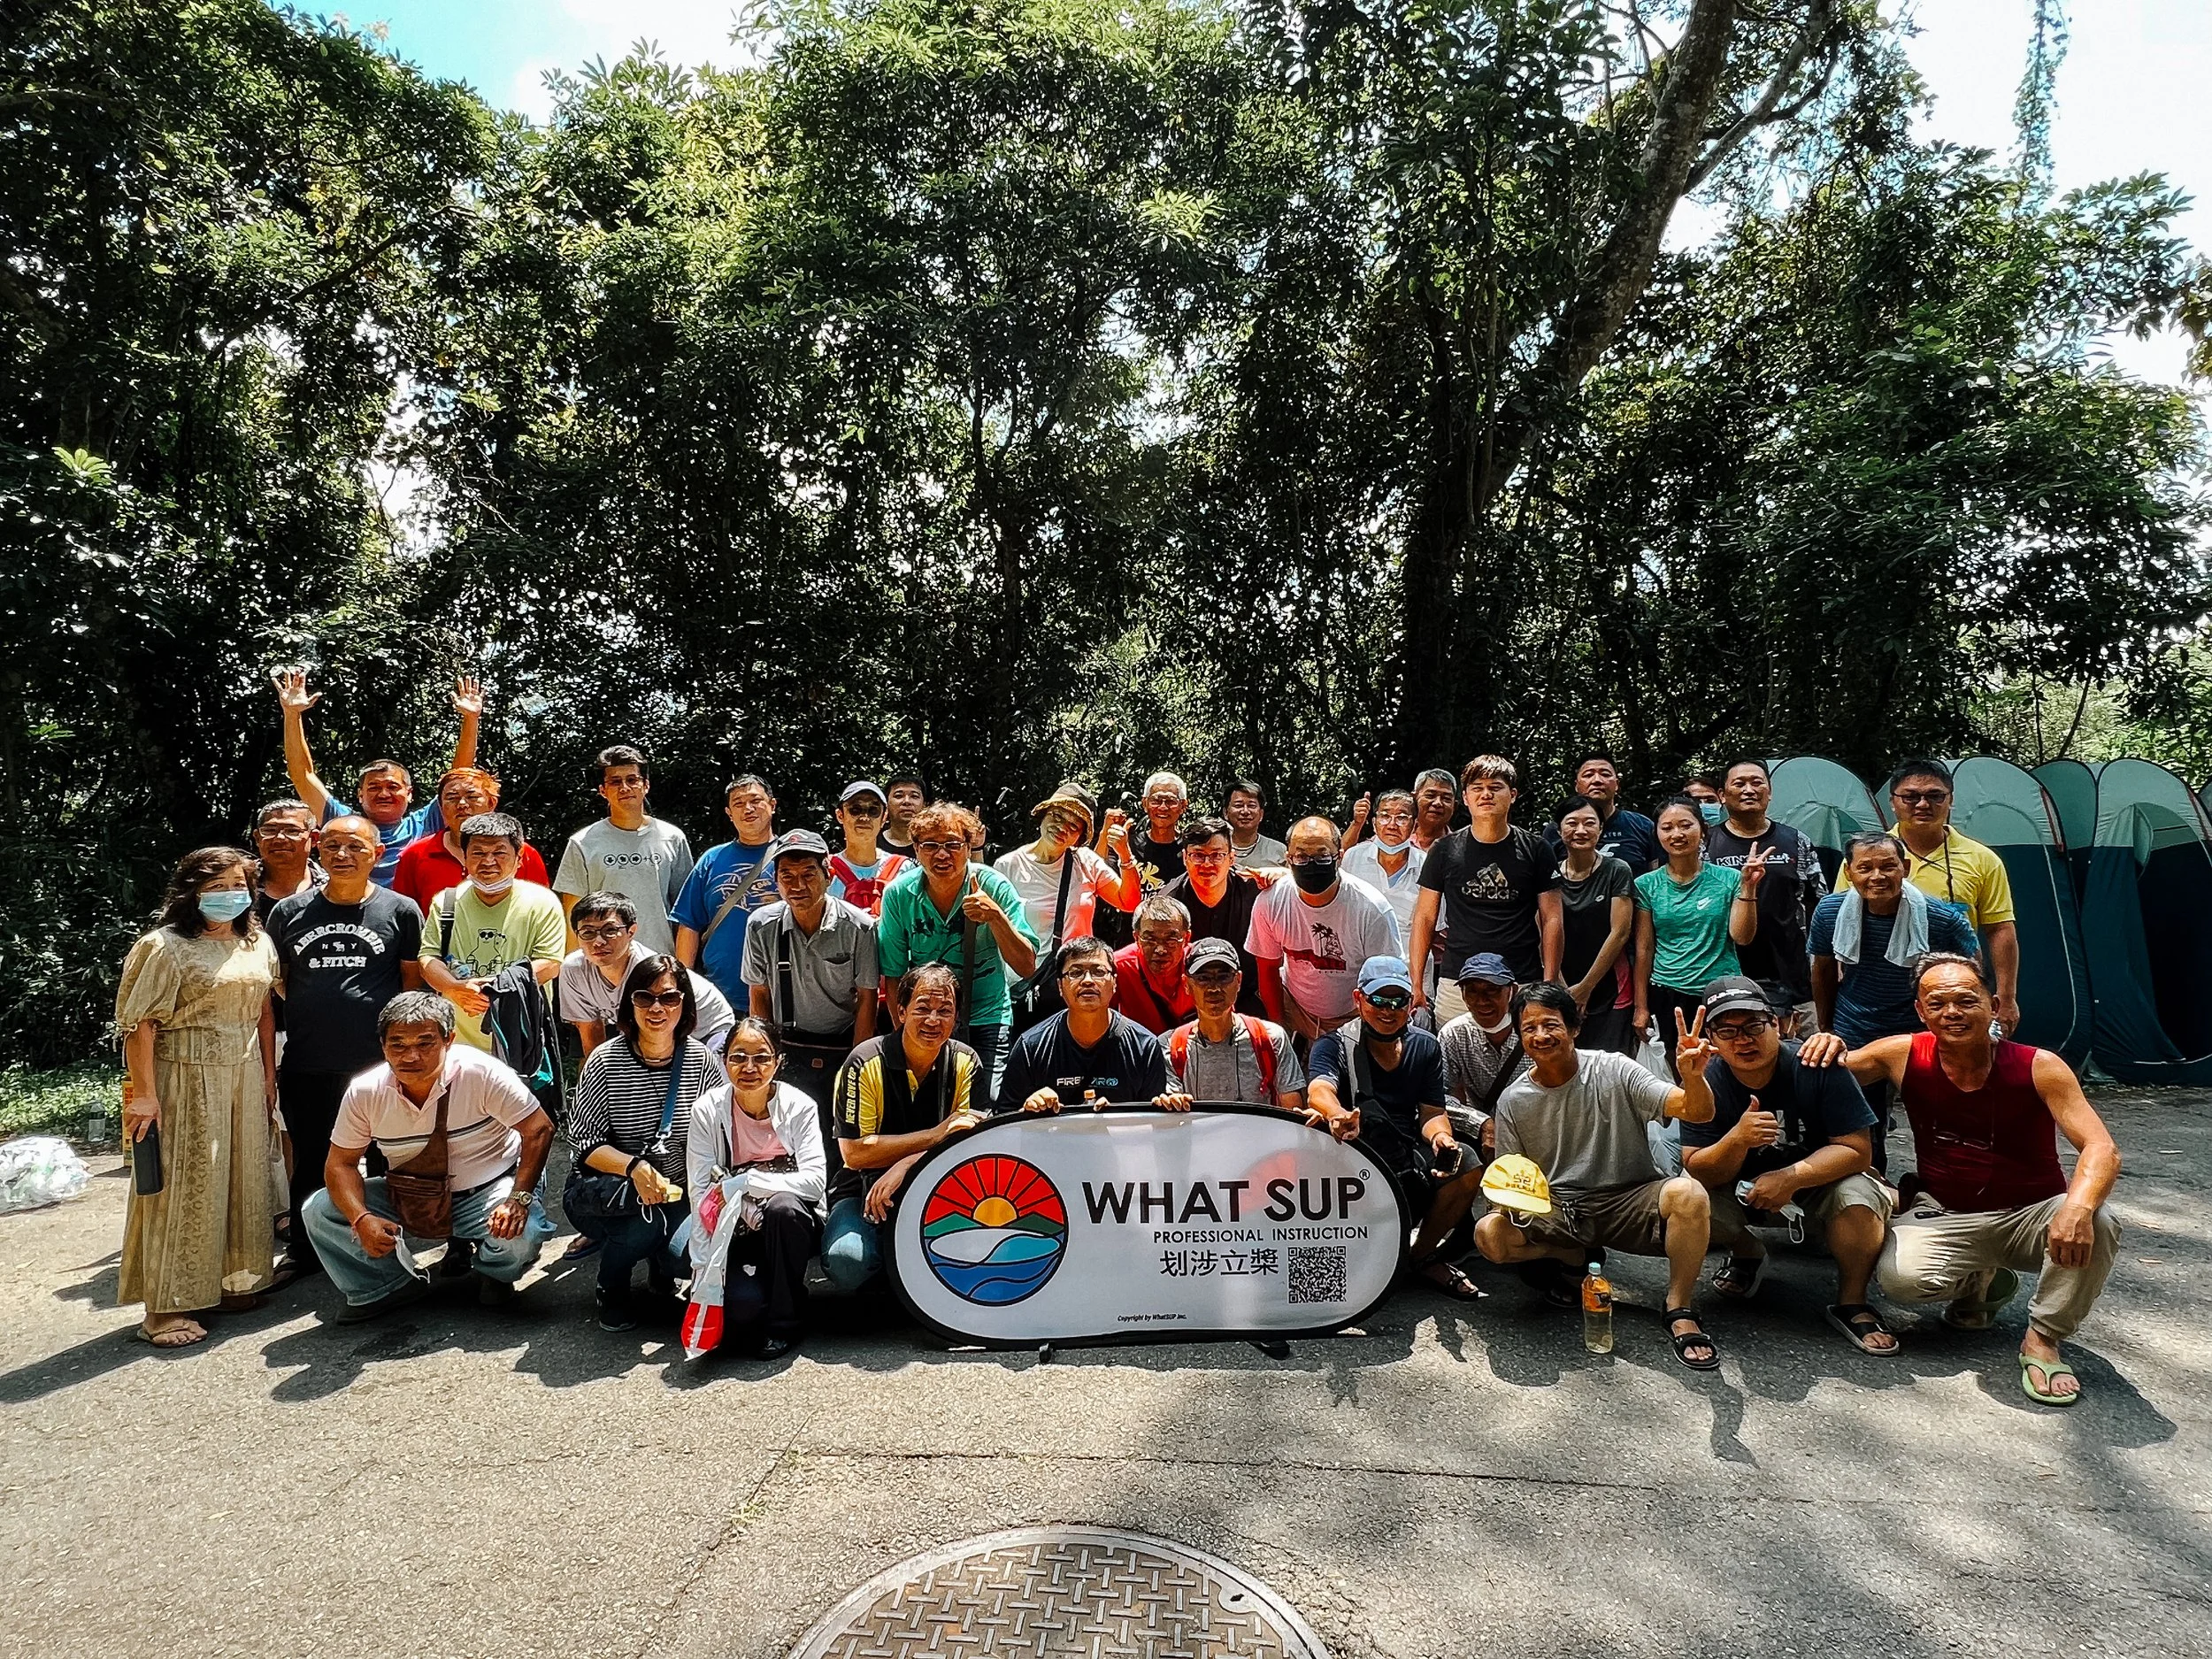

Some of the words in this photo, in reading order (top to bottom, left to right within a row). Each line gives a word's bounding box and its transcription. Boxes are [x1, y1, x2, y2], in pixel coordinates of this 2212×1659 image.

[294, 923, 386, 956] ABERCROMBIE
[321, 956, 367, 968] FITCH
[847, 1066, 856, 1080] UP
[846, 1080, 856, 1098] GIVE
[845, 1098, 856, 1125] NEVER
[1081, 1179, 1249, 1225] WHAT
[1263, 1177, 1366, 1223] SUP
[1153, 1228, 1264, 1244] PROFESSIONAL
[1271, 1225, 1369, 1240] INSTRUCTION
[1159, 1248, 1279, 1277] 划涉立槳
